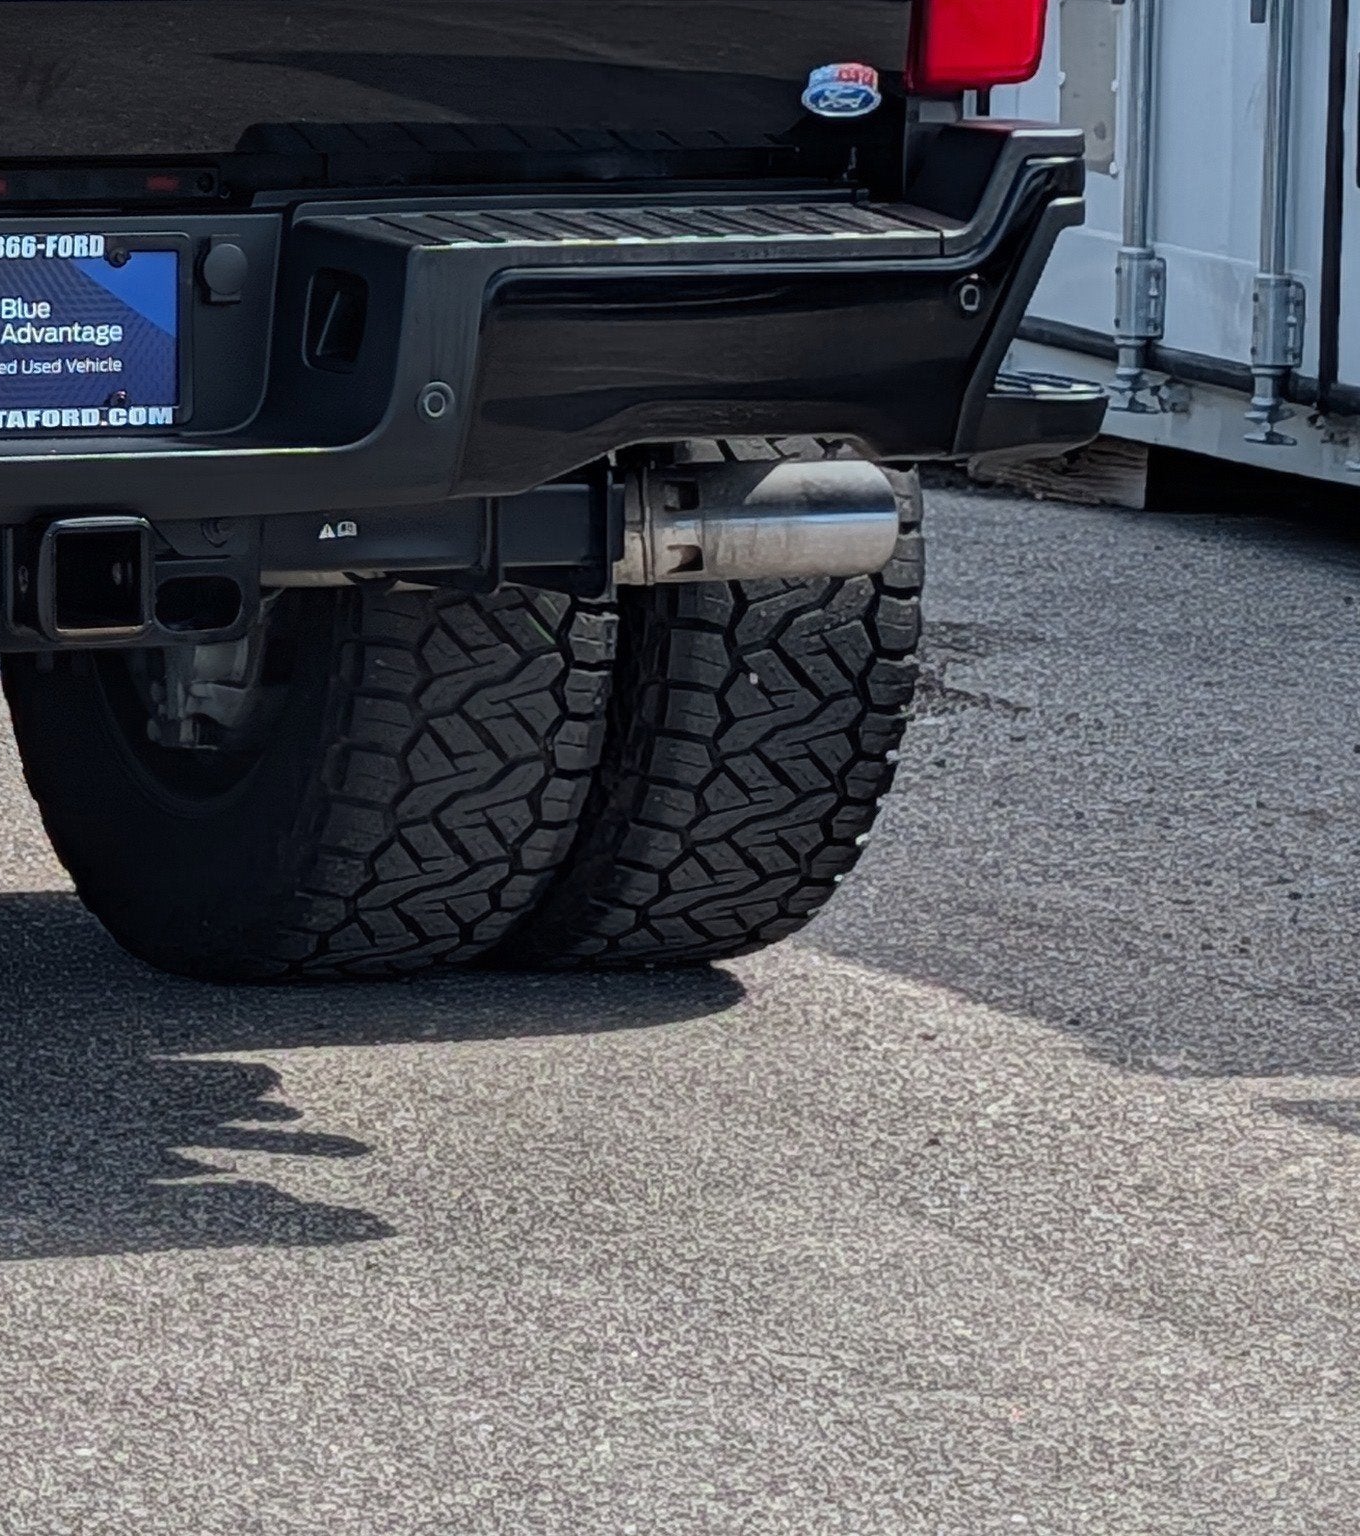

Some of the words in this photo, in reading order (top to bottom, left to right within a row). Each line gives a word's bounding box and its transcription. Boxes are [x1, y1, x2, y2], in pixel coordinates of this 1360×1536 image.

[1, 297, 51, 319] Blue
[0, 323, 123, 346] Advantage
[22, 358, 63, 375] Used
[66, 356, 122, 373] Vehicle
